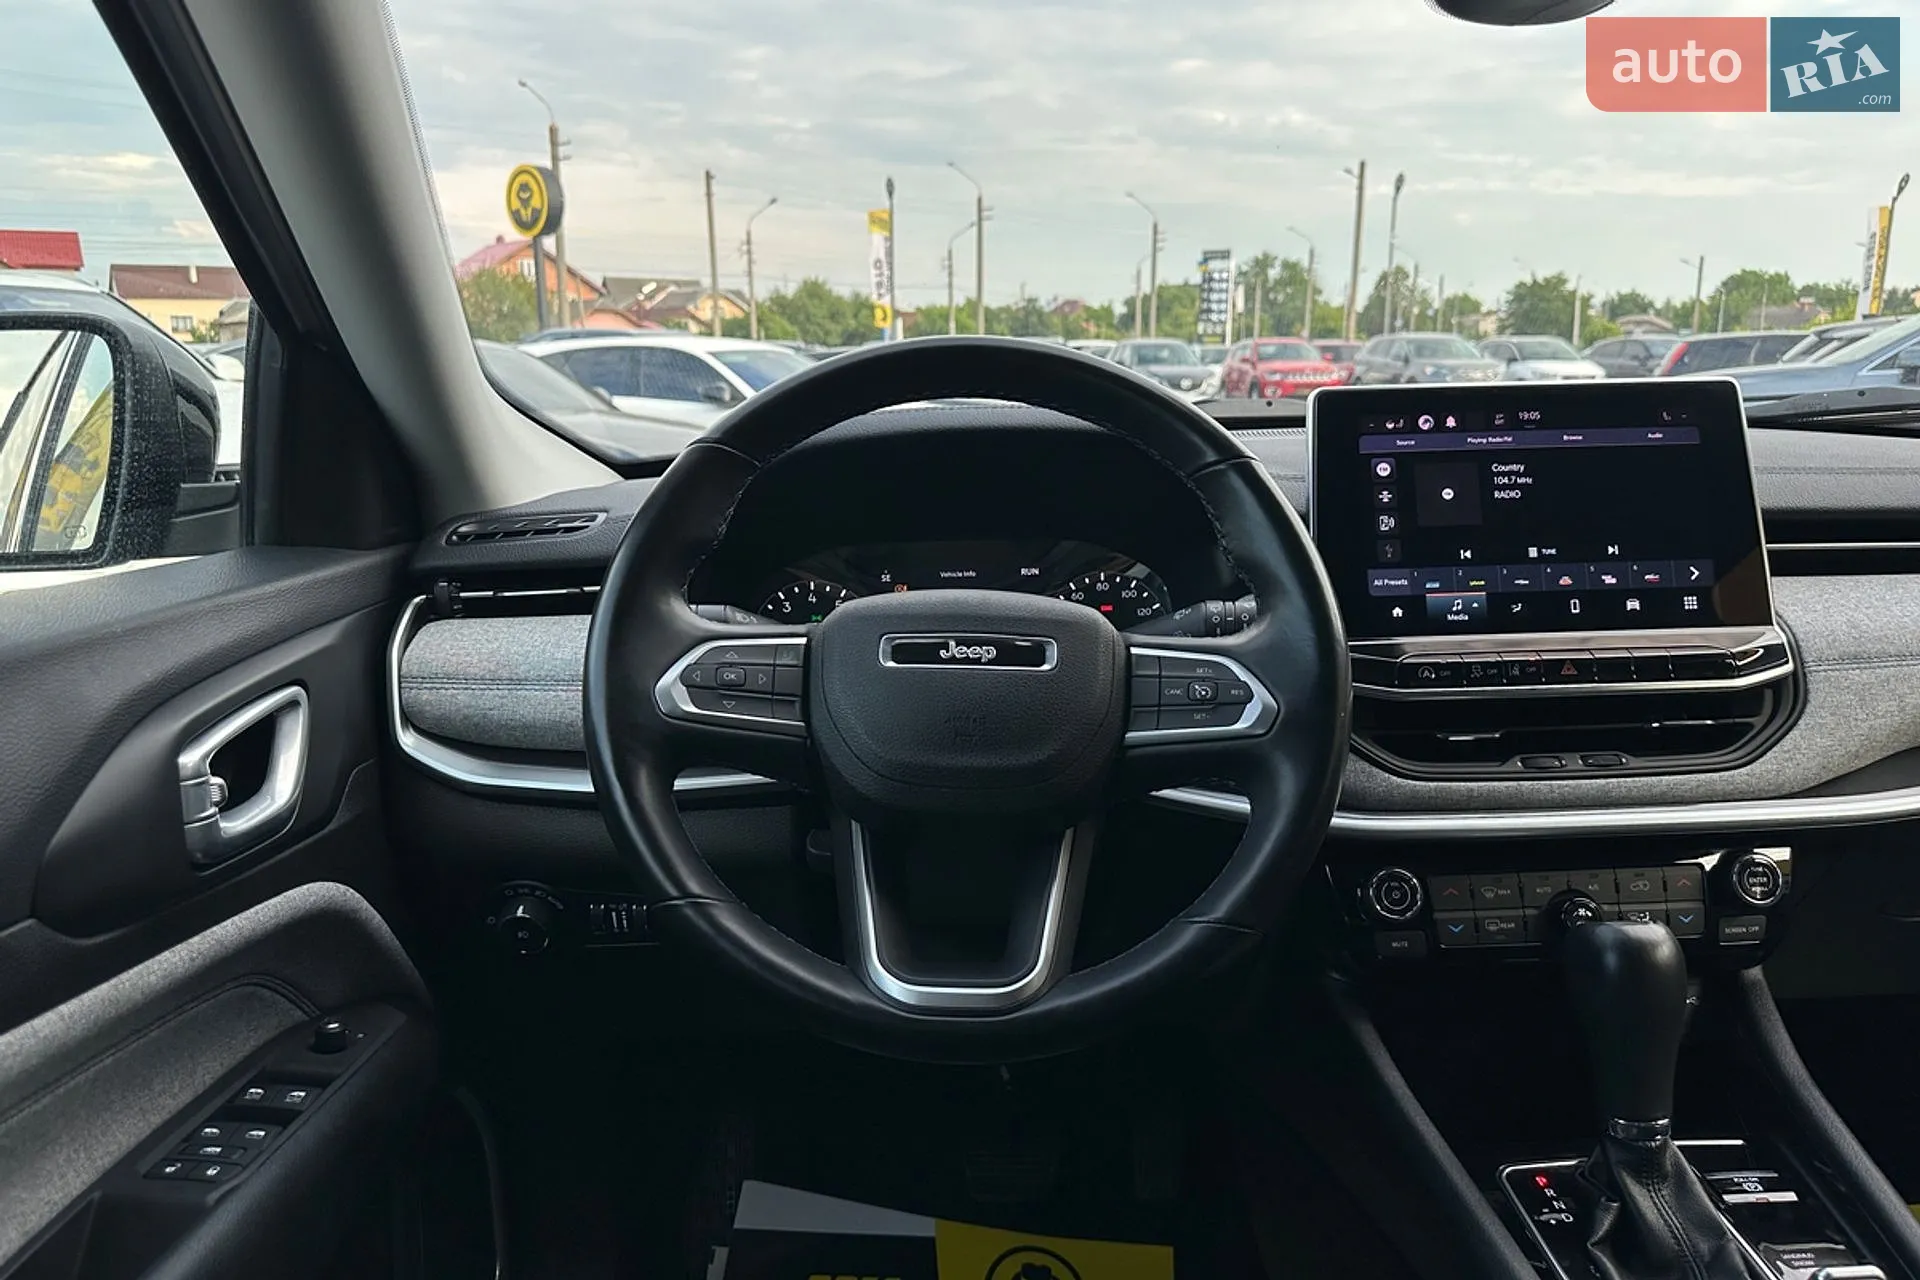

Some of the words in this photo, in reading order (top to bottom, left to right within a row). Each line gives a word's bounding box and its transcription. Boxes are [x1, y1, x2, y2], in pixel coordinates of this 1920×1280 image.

[1467, 436, 1487, 445] Playing
[1491, 463, 1525, 473] Country
[1493, 476, 1516, 485] 104.7
[1516, 477, 1533, 485] MHz
[1494, 490, 1521, 499] RADIO
[1021, 567, 1040, 576] RUN
[1096, 582, 1110, 591] 80
[1373, 578, 1383, 586] All
[1384, 578, 1408, 587] Presets
[808, 592, 817, 604] 4
[1070, 592, 1085, 601] 60
[1121, 590, 1138, 598] 100
[782, 601, 792, 613] 3
[1137, 608, 1152, 616] 120
[1447, 613, 1469, 621] Media
[939, 640, 997, 662] Jeep
[723, 672, 737, 680] OK
[1544, 1188, 1557, 1198] R
[1552, 1200, 1566, 1210] N
